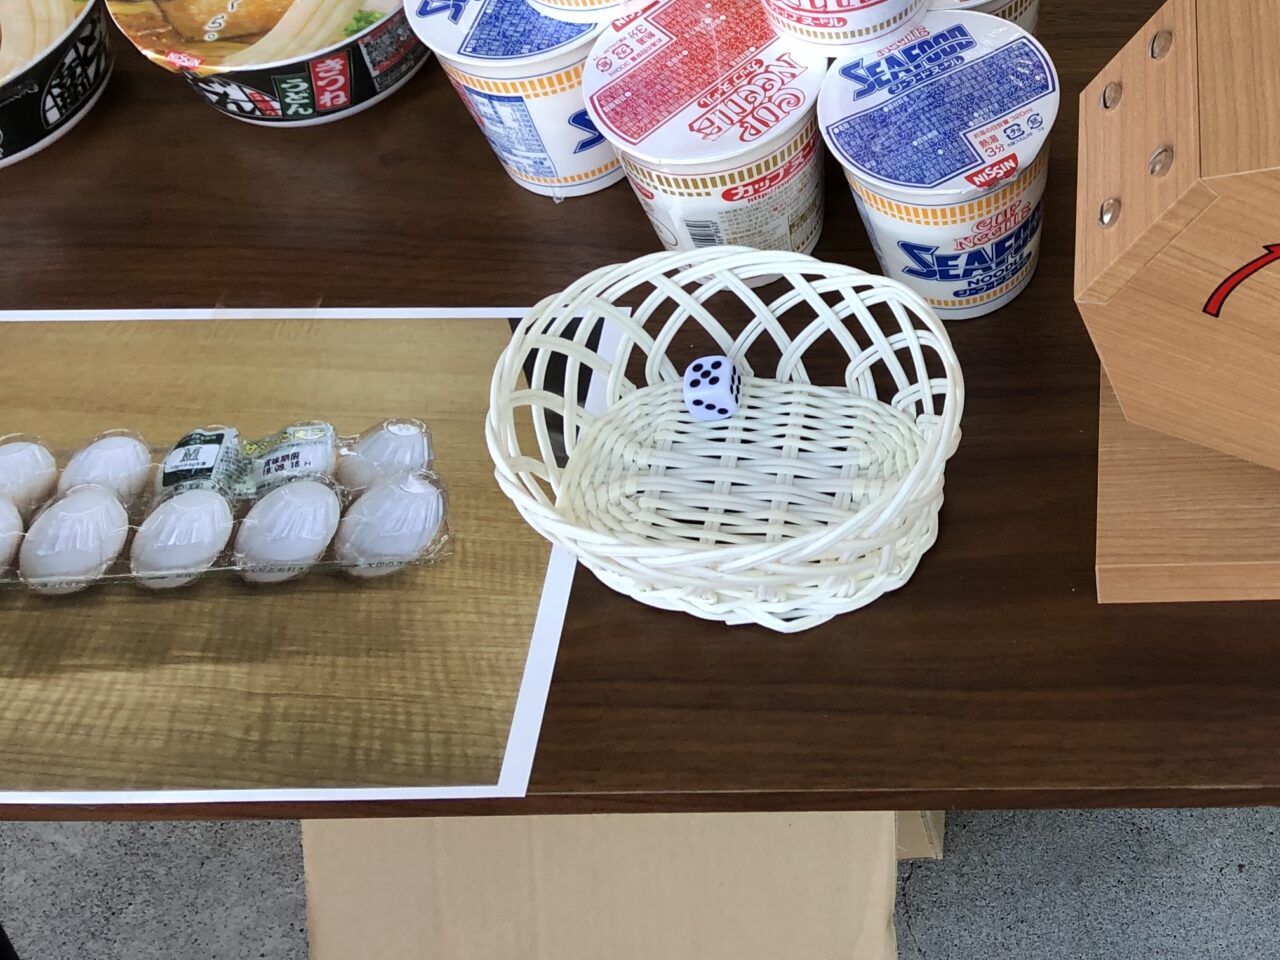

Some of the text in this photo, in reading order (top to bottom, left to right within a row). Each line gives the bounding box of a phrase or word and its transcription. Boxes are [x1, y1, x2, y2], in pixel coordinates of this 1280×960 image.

[313, 56, 348, 107] きつね
[839, 23, 977, 102] SEAFOOD
[282, 78, 313, 116] うどん
[688, 53, 808, 140] NOODLE
[740, 88, 806, 142] CUP
[985, 144, 1006, 158] 3分
[973, 159, 1015, 186] NISSIN
[954, 202, 1031, 251] NOODLE
[971, 200, 1022, 234] CUP
[968, 253, 1025, 288] NOODLE
[180, 446, 201, 463] M
